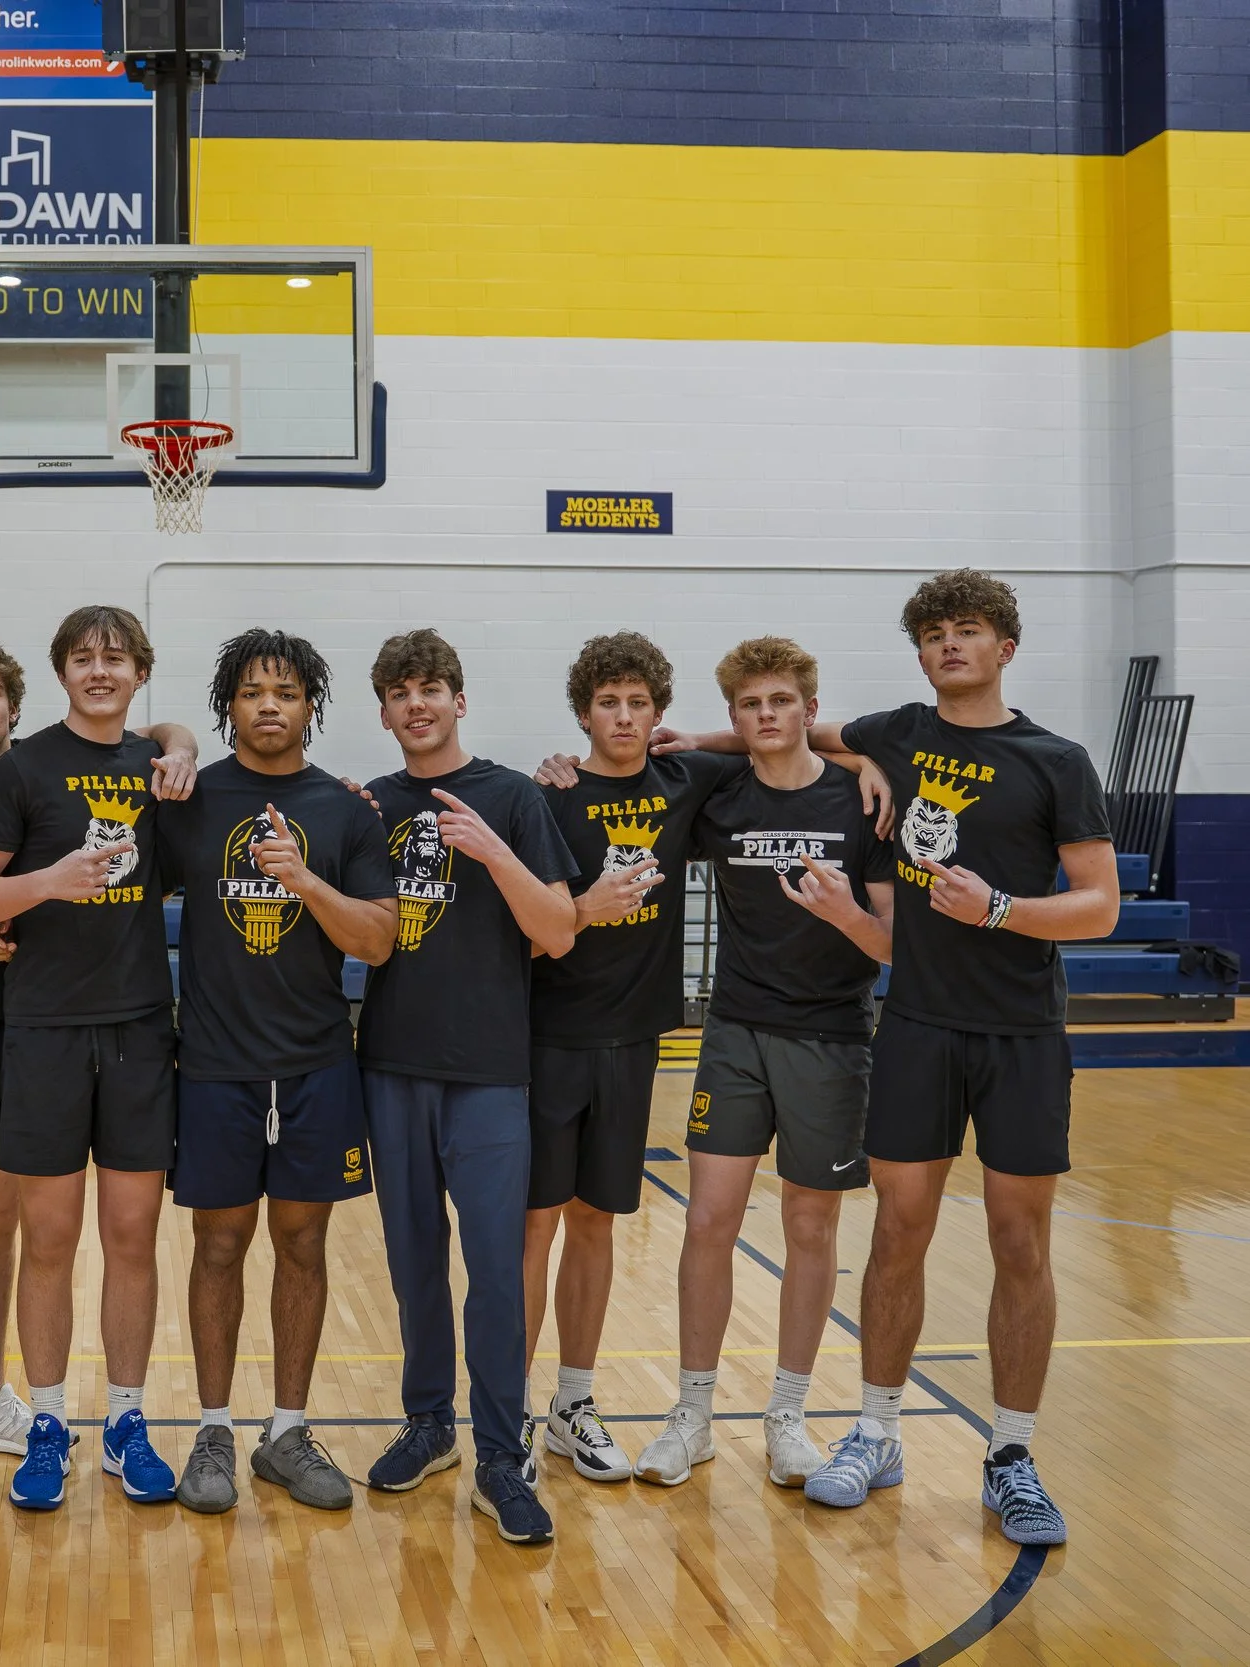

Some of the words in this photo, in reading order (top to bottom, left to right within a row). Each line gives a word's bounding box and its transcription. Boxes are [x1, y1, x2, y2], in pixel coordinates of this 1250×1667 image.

[23, 287, 63, 315] TO
[78, 288, 143, 315] WIN
[566, 497, 655, 513] MOELLER
[560, 511, 660, 528] STUDENTS
[911, 751, 996, 783] PILLAR
[65, 775, 147, 791] PILLAR
[587, 796, 668, 820] PILLAR
[743, 839, 825, 858] PILLAR
[776, 860, 788, 869] M
[72, 886, 144, 904] OUSE
[395, 880, 446, 899] LLAR
